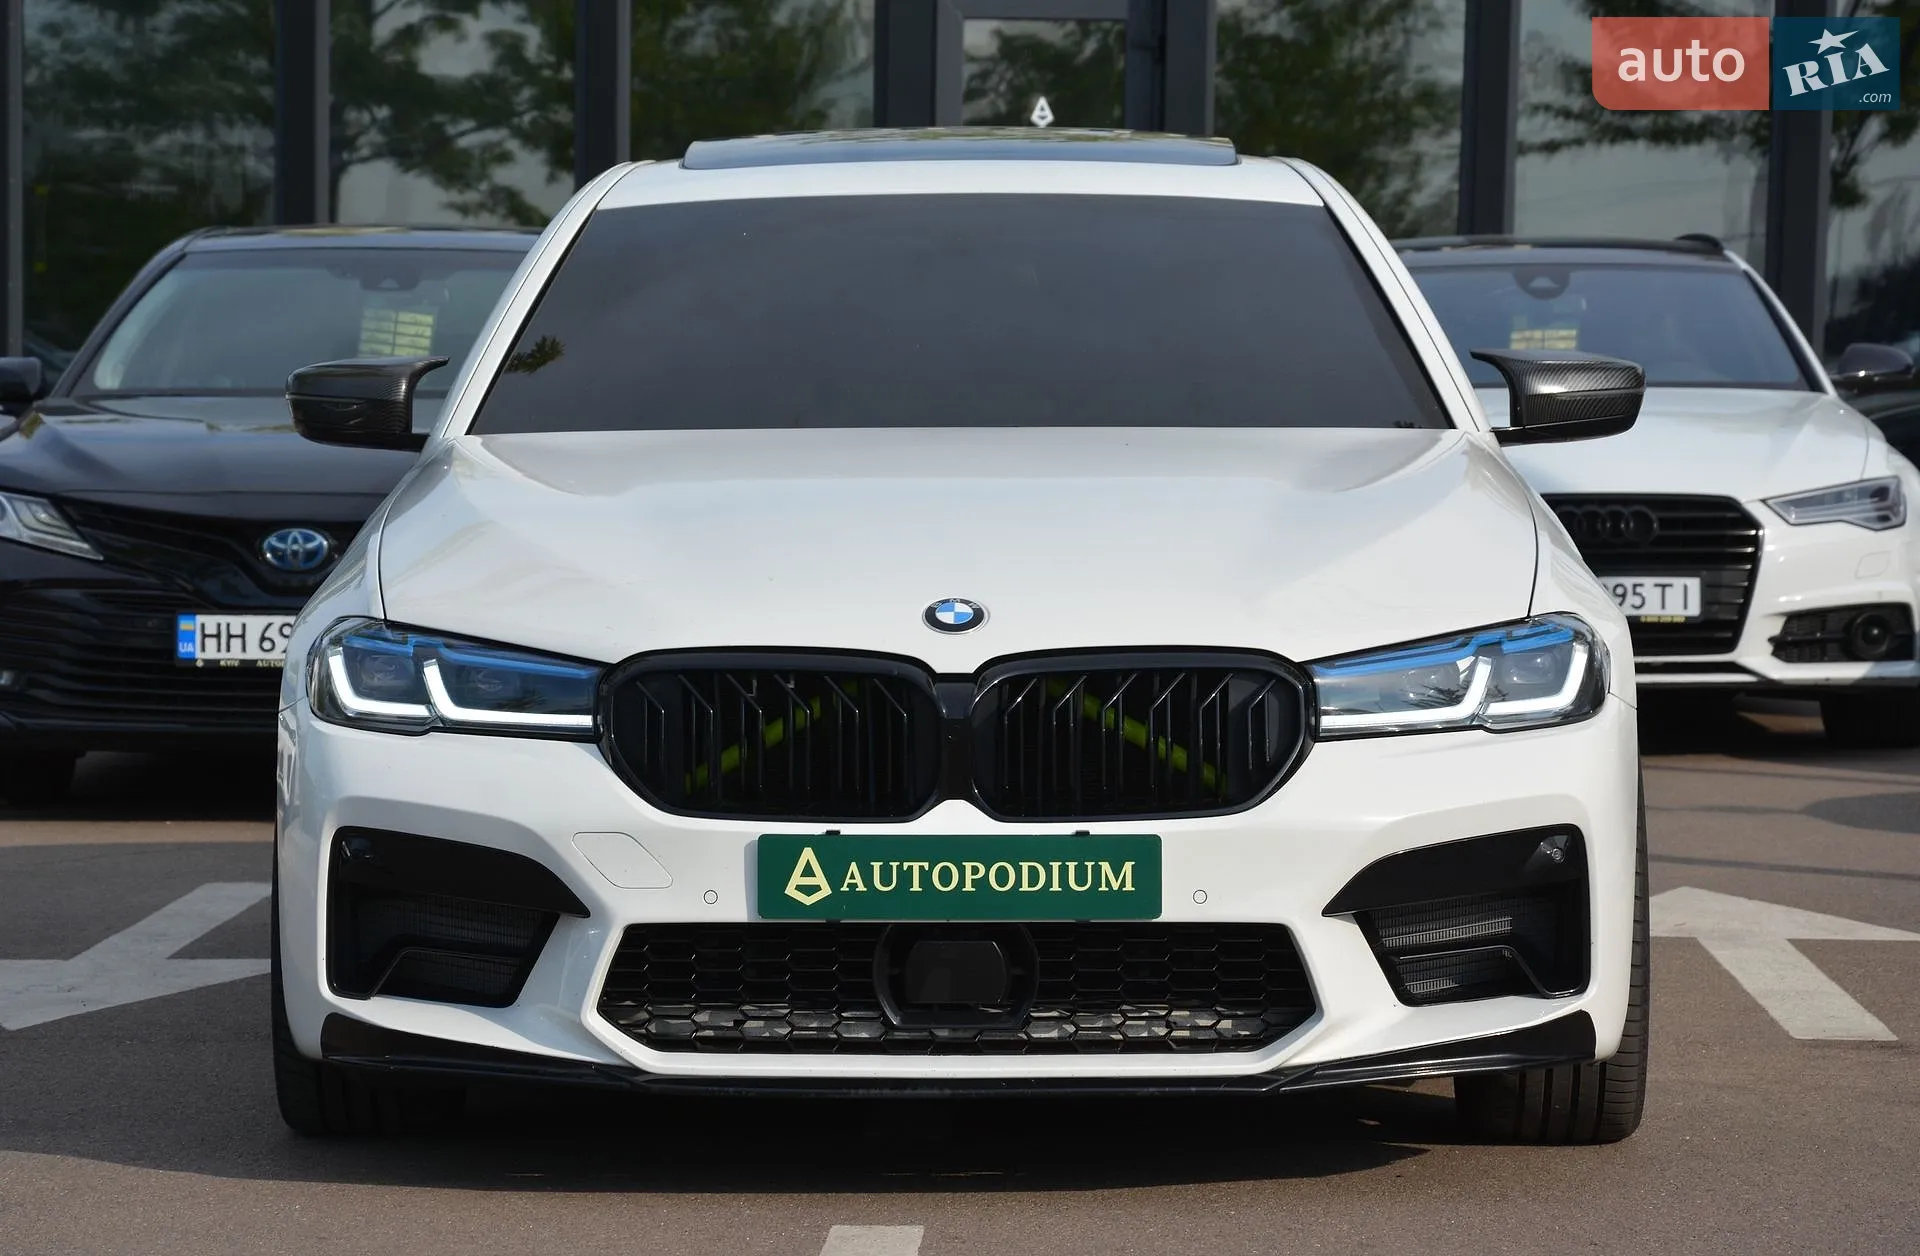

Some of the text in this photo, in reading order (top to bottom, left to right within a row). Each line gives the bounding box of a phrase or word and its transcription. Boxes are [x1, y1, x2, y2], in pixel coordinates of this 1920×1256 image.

[179, 642, 194, 652] UA
[200, 622, 247, 653] HH
[840, 861, 1136, 892] AUTOPODIUM
